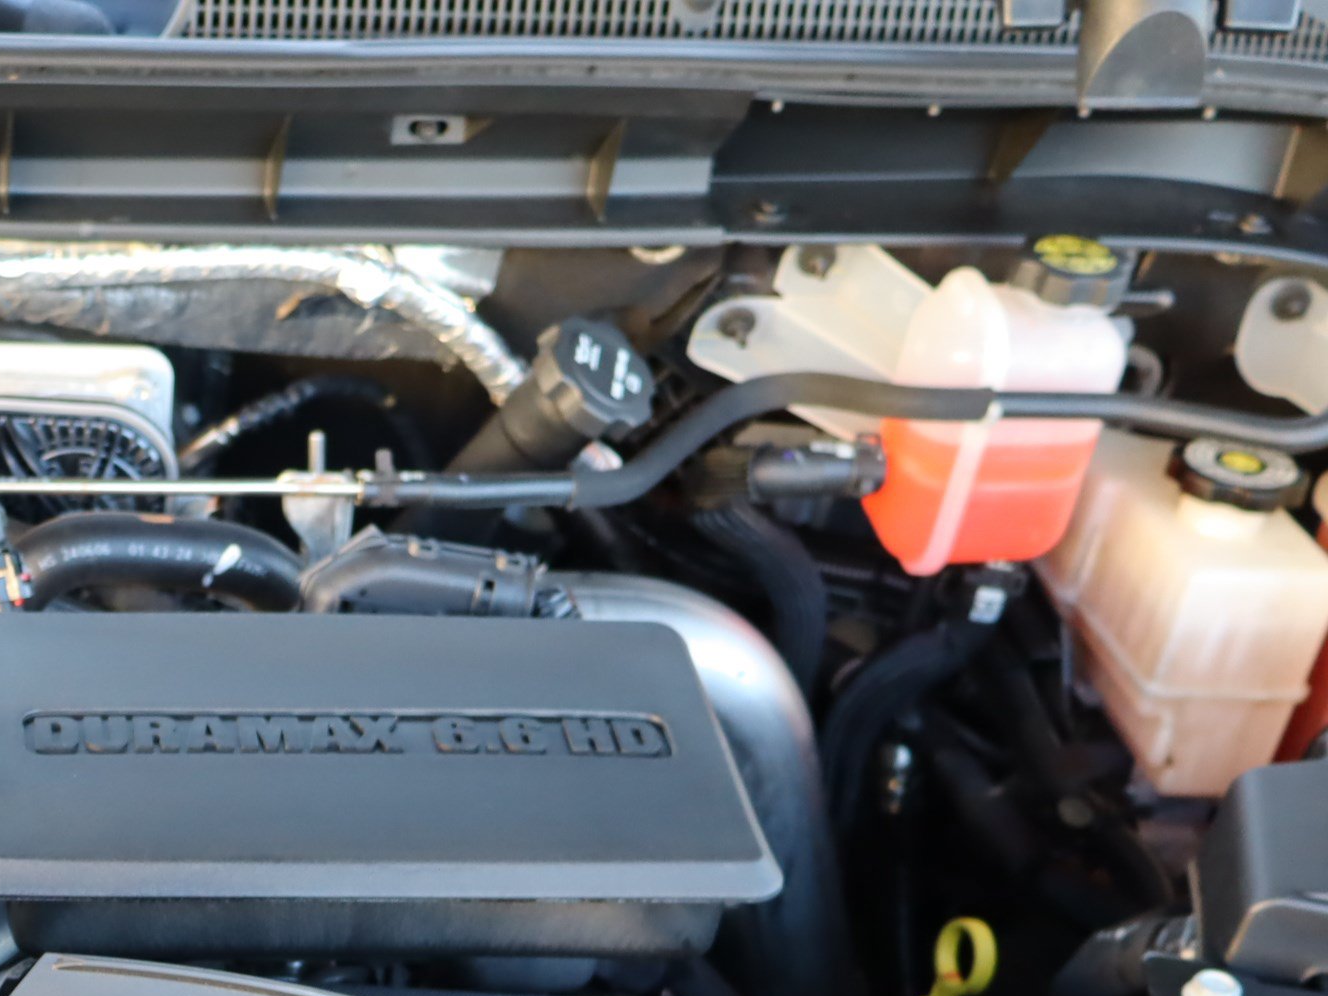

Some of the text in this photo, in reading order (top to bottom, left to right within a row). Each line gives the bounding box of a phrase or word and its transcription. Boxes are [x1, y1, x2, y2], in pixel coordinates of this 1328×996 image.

[29, 714, 665, 757] DURAMAX 6.6 HD
